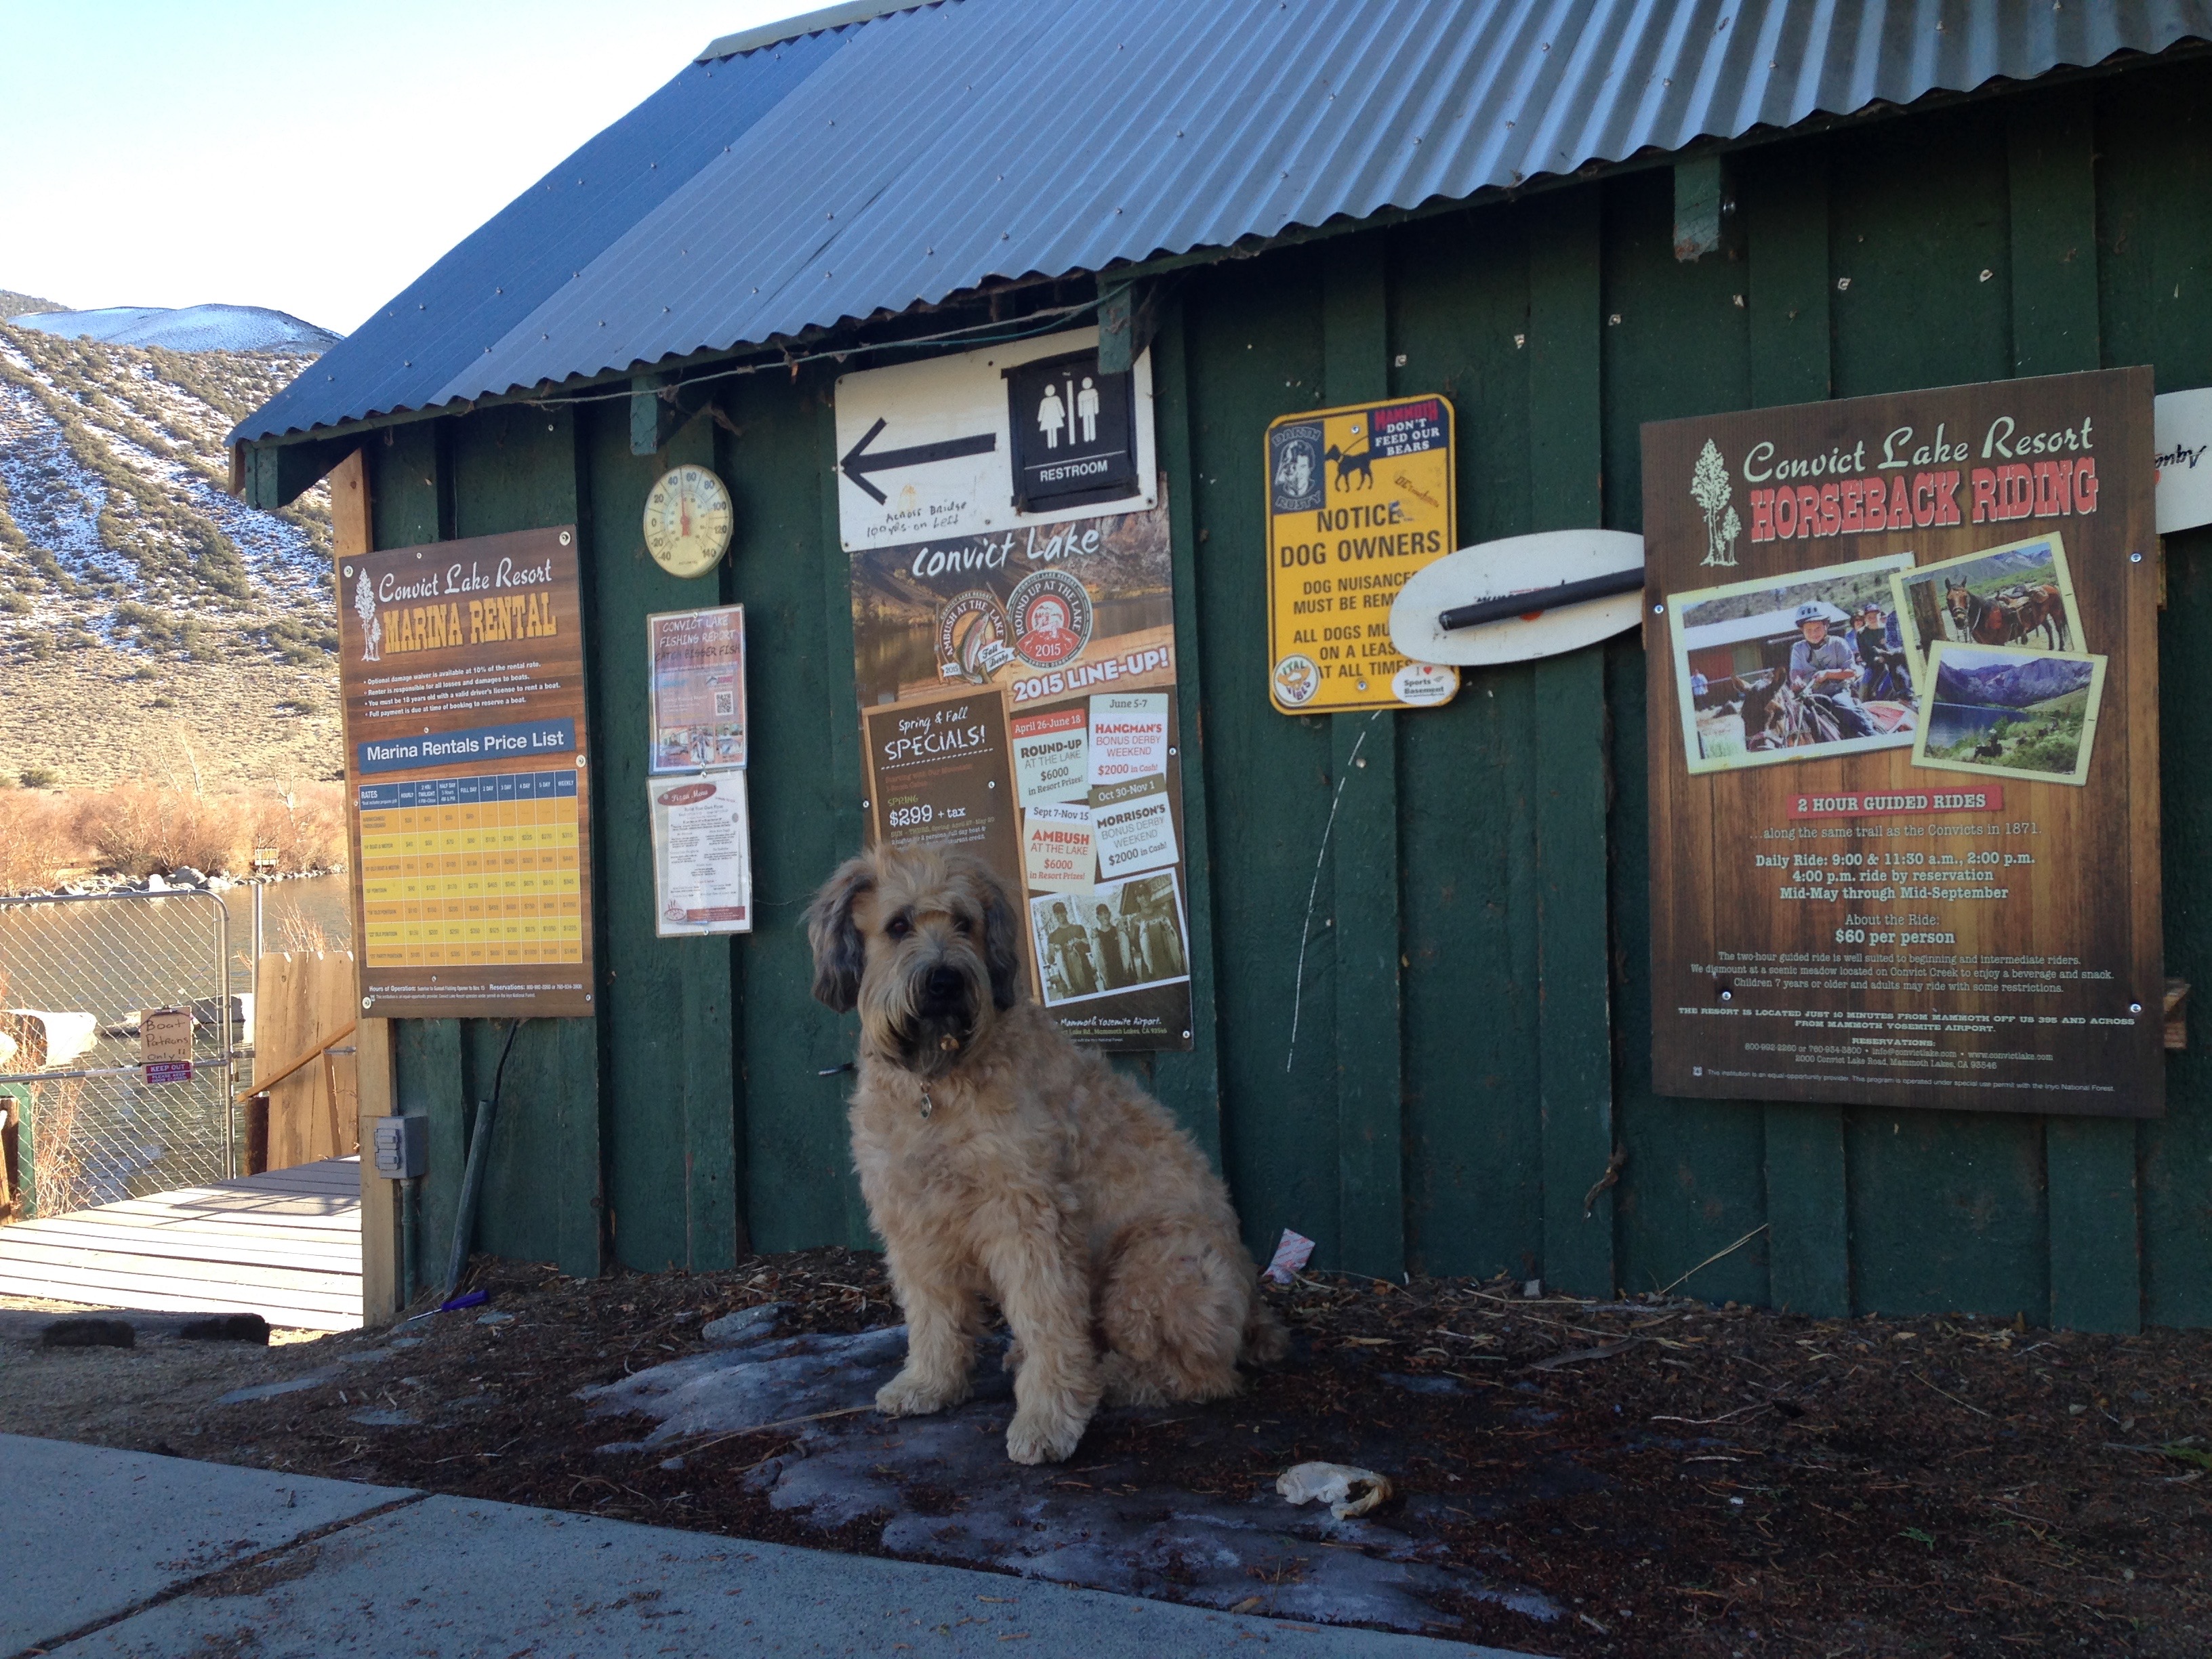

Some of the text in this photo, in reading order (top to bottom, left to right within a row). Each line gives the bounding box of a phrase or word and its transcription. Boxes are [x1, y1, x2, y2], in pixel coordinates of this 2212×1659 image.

[1374, 401, 1438, 431] MAMMOTH
[1387, 417, 1427, 434] DON'T
[1375, 427, 1440, 447] FEED OUR
[1387, 441, 1430, 456] BEARS
[1743, 415, 2093, 483] Convict Lake Resort
[1040, 460, 1108, 483] RESTROOM
[654, 494, 664, 504] 20
[1750, 456, 2100, 543] HORSEBACK RIDING
[651, 518, 657, 527] 0
[1317, 502, 1401, 533] NOTICE
[912, 523, 1100, 577] Convict Lake
[1281, 530, 1441, 568] DOG OWNERS
[378, 557, 552, 602] Convict Lake Resort
[1303, 579, 1332, 595] DOG
[1015, 581, 1082, 637] ROUND UP AT THE LAKE
[1293, 598, 1334, 615] MUST
[1339, 596, 1356, 611] BE
[384, 592, 558, 654] MARINA RENTAL
[663, 615, 729, 632] CONVICT LAKE
[943, 600, 1003, 656] AMBUSH AT THE LAKE
[660, 630, 736, 648] FISHING REPORT
[1294, 625, 1361, 644] ALL DOGS
[982, 643, 998, 659] Fall
[1035, 643, 1061, 657] 2015
[1320, 644, 1355, 660] ON A
[1013, 647, 1169, 702] 2015 LINE-UP!
[1338, 663, 1364, 678] ALL
[1404, 678, 1431, 687] Sports
[1109, 699, 1147, 709] June 5-7
[899, 705, 968, 735] Spring & Fall
[1015, 715, 1082, 735] April 26-June 18
[1095, 723, 1162, 734] HANGMAN'S
[367, 731, 564, 761] Marina Rentals Price List
[884, 724, 985, 760] SPECIALS!
[1021, 739, 1082, 758] ROUND-UP
[1096, 735, 1162, 746] BONUS DERBY
[1106, 746, 1152, 757] WEEKEND
[1040, 766, 1069, 782] $6000
[1098, 764, 1128, 777] $2000
[1099, 781, 1155, 801] Oct 30-Nov 1
[888, 794, 919, 806] SPRING
[1797, 794, 1986, 813] 2 HOUR GUIDED RIDES
[889, 804, 966, 827] $299 tax
[1033, 806, 1089, 821] Sept 7-Nov 15
[1097, 804, 1166, 828] MORRISON'S
[1101, 815, 1165, 840] BONUS DERBY
[1798, 826, 1818, 838] the
[1821, 827, 1853, 838] same
[1856, 825, 1883, 837] trail
[1886, 827, 1901, 837] as
[1904, 824, 1925, 836] the
[1928, 823, 1984, 836] Convicts
[1987, 823, 2000, 835] in
[2004, 823, 2042, 835] 1871.
[1031, 829, 1090, 845] AMBUSH
[1112, 829, 1158, 848] WEEKEND
[1044, 859, 1073, 869] $6000
[1108, 848, 1139, 866] $2000
[1755, 852, 2036, 869] Daily Ride: 9:00 & 11:30 a.m., 2:00 p.m.
[1793, 869, 1994, 884] 4:00 p.m. ride by reservation
[1780, 886, 2009, 902] Mid-May through Mid-September
[1844, 914, 1881, 925] About
[1884, 914, 1906, 925] the
[1835, 928, 1955, 946] $60 per person
[1718, 951, 2082, 965] The two-hour guided ride is well suited to beginning and intermediate riders.
[146, 1019, 185, 1031] Boat
[1061, 1016, 1097, 1027] Mammoth
[1098, 1017, 1131, 1026] Yosemite
